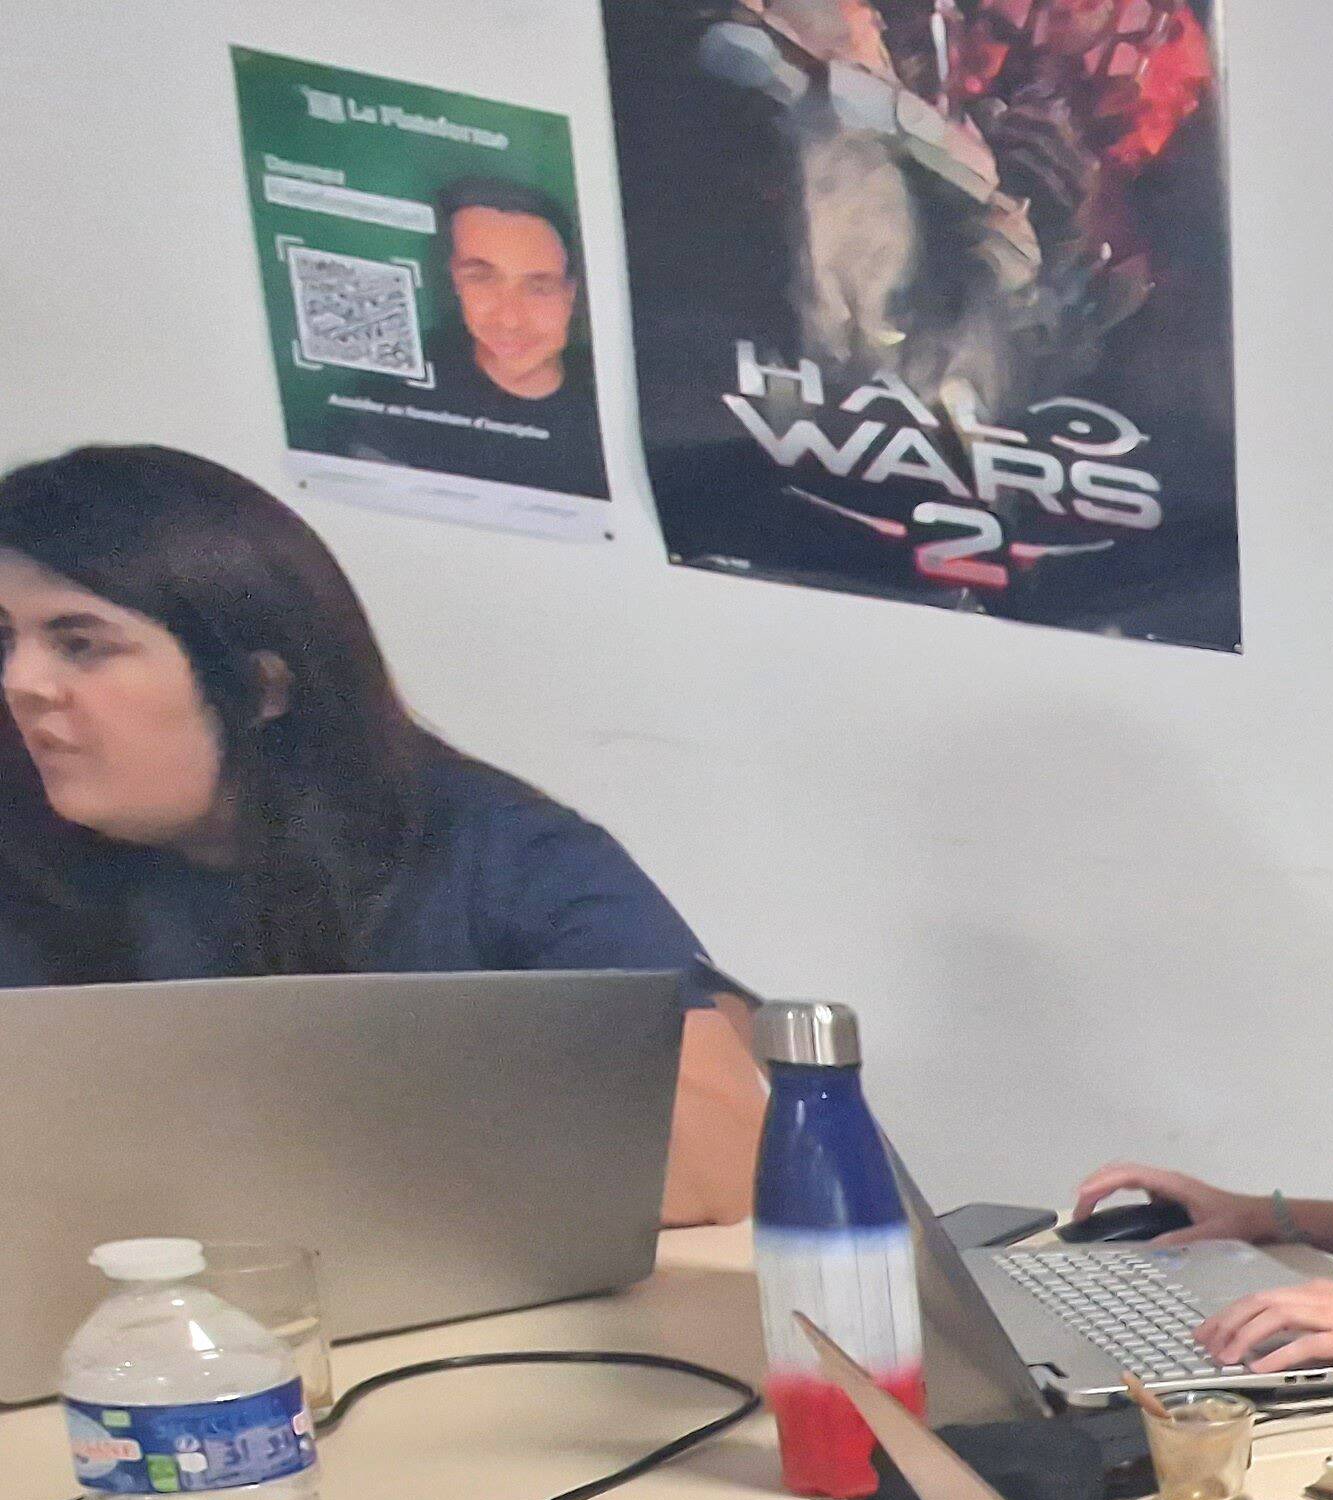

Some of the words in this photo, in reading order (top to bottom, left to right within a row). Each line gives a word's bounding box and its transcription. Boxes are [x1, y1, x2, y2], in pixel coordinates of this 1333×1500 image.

[736, 338, 1152, 456] HALO
[722, 393, 1163, 531] WARS
[912, 500, 1010, 588] 2
